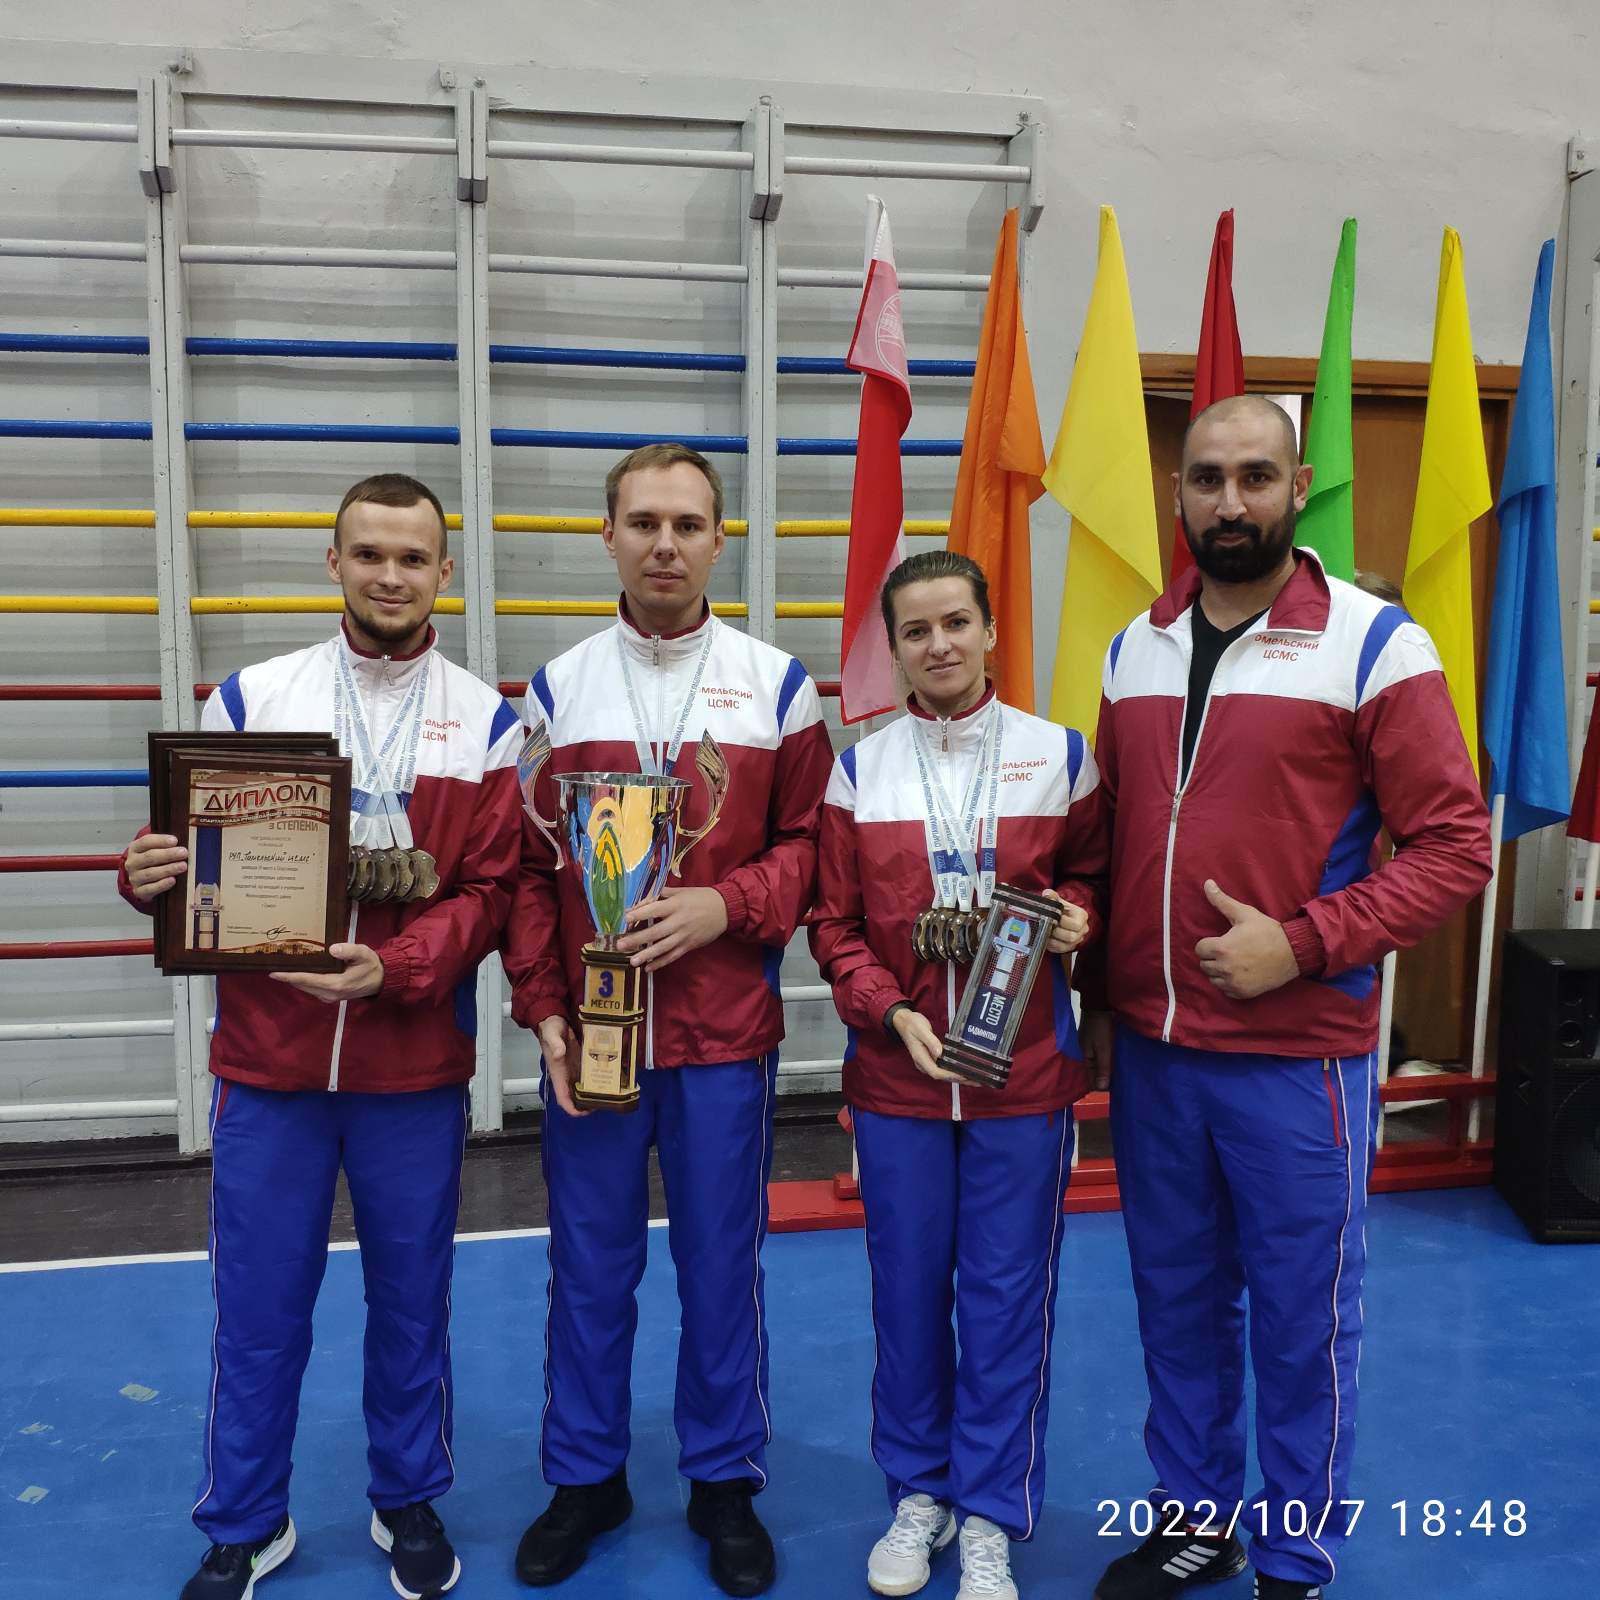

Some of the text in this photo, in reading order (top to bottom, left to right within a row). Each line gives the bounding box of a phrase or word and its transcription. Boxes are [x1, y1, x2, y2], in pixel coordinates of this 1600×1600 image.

[1255, 634, 1319, 650] омельский
[1263, 650, 1299, 661] ЦСМС
[701, 687, 753, 700] мельский
[707, 698, 740, 709] ЦСМС
[422, 730, 447, 742] ЦСМ
[1001, 757, 1048, 770] ельский
[204, 785, 317, 812] ДИПЛОМ
[277, 820, 319, 832] СТЕПЕНИ
[984, 852, 994, 867] 2022
[598, 971, 614, 998] 3
[591, 999, 620, 1010] МЕСТО
[980, 991, 1007, 1026] 1 МЕСТО
[967, 1025, 998, 1041] БАДМИНТОН
